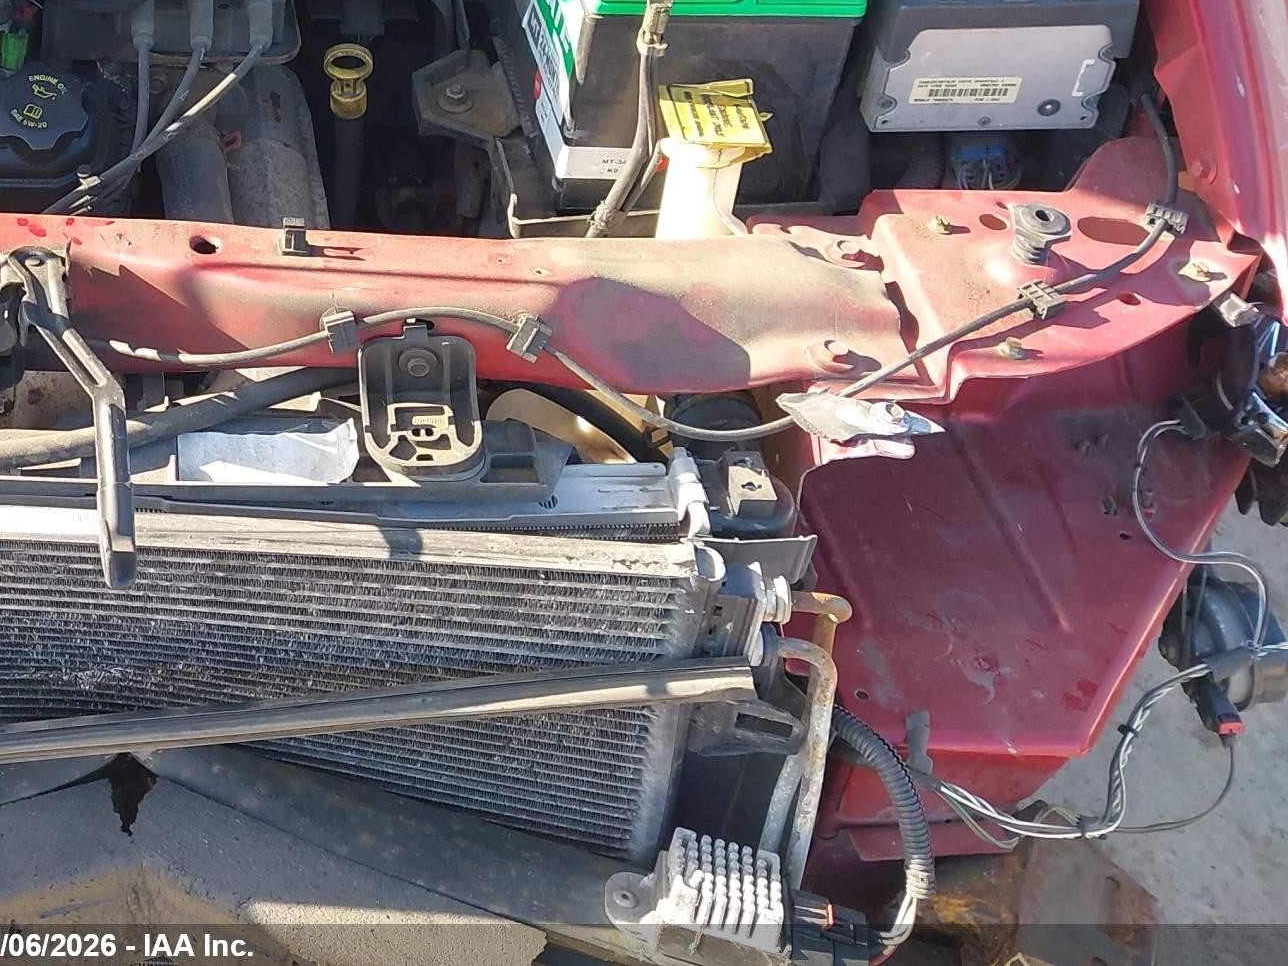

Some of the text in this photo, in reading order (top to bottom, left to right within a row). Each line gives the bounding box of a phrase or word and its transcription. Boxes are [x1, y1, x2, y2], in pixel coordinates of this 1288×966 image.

[28, 74, 68, 96] ENGINE OIL
[10, 108, 24, 123] SAE
